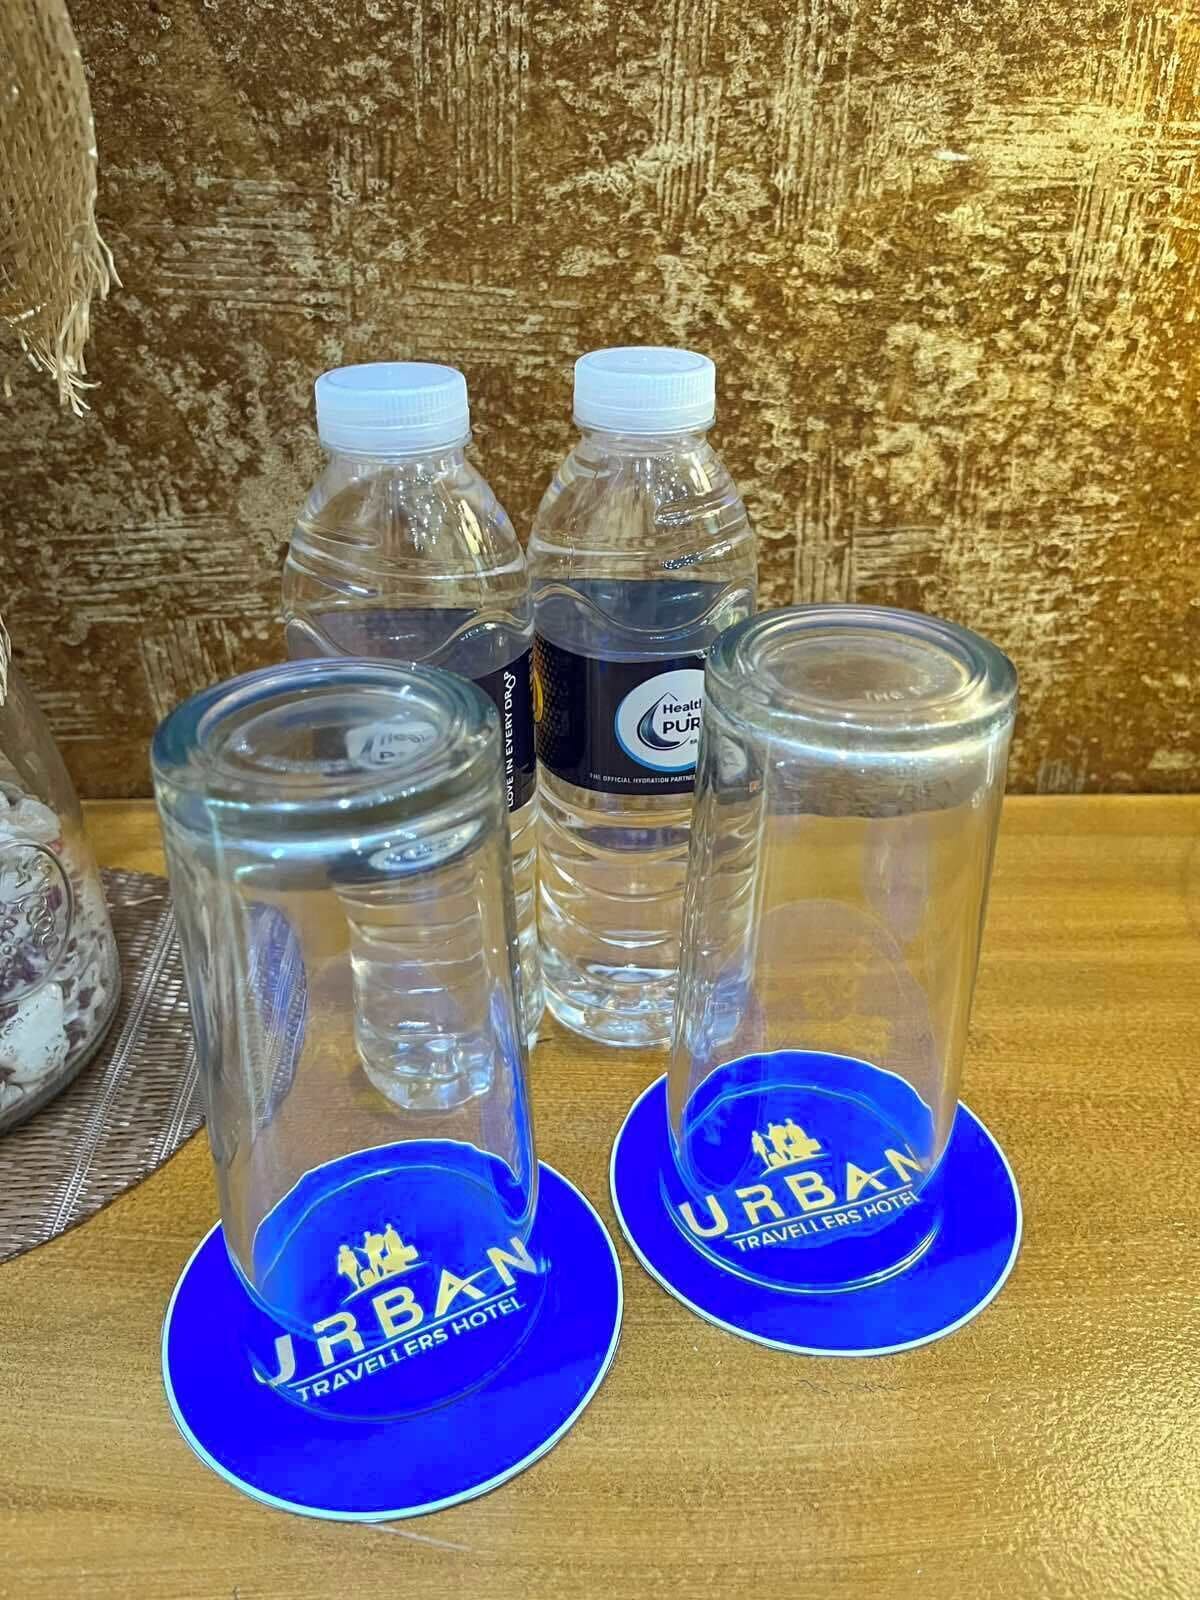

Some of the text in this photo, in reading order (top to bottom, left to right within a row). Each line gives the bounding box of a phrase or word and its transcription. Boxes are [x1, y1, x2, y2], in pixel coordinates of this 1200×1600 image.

[503, 671, 516, 807] LOVE IN EVERY DROP
[602, 775, 631, 784] OFFICIAL
[633, 776, 669, 784] HYDRATION
[678, 1144, 926, 1238] URBAN
[733, 1190, 920, 1252] TRAVELLERS HOTEL
[295, 1296, 527, 1402] TRAVELLERS HOTEL
